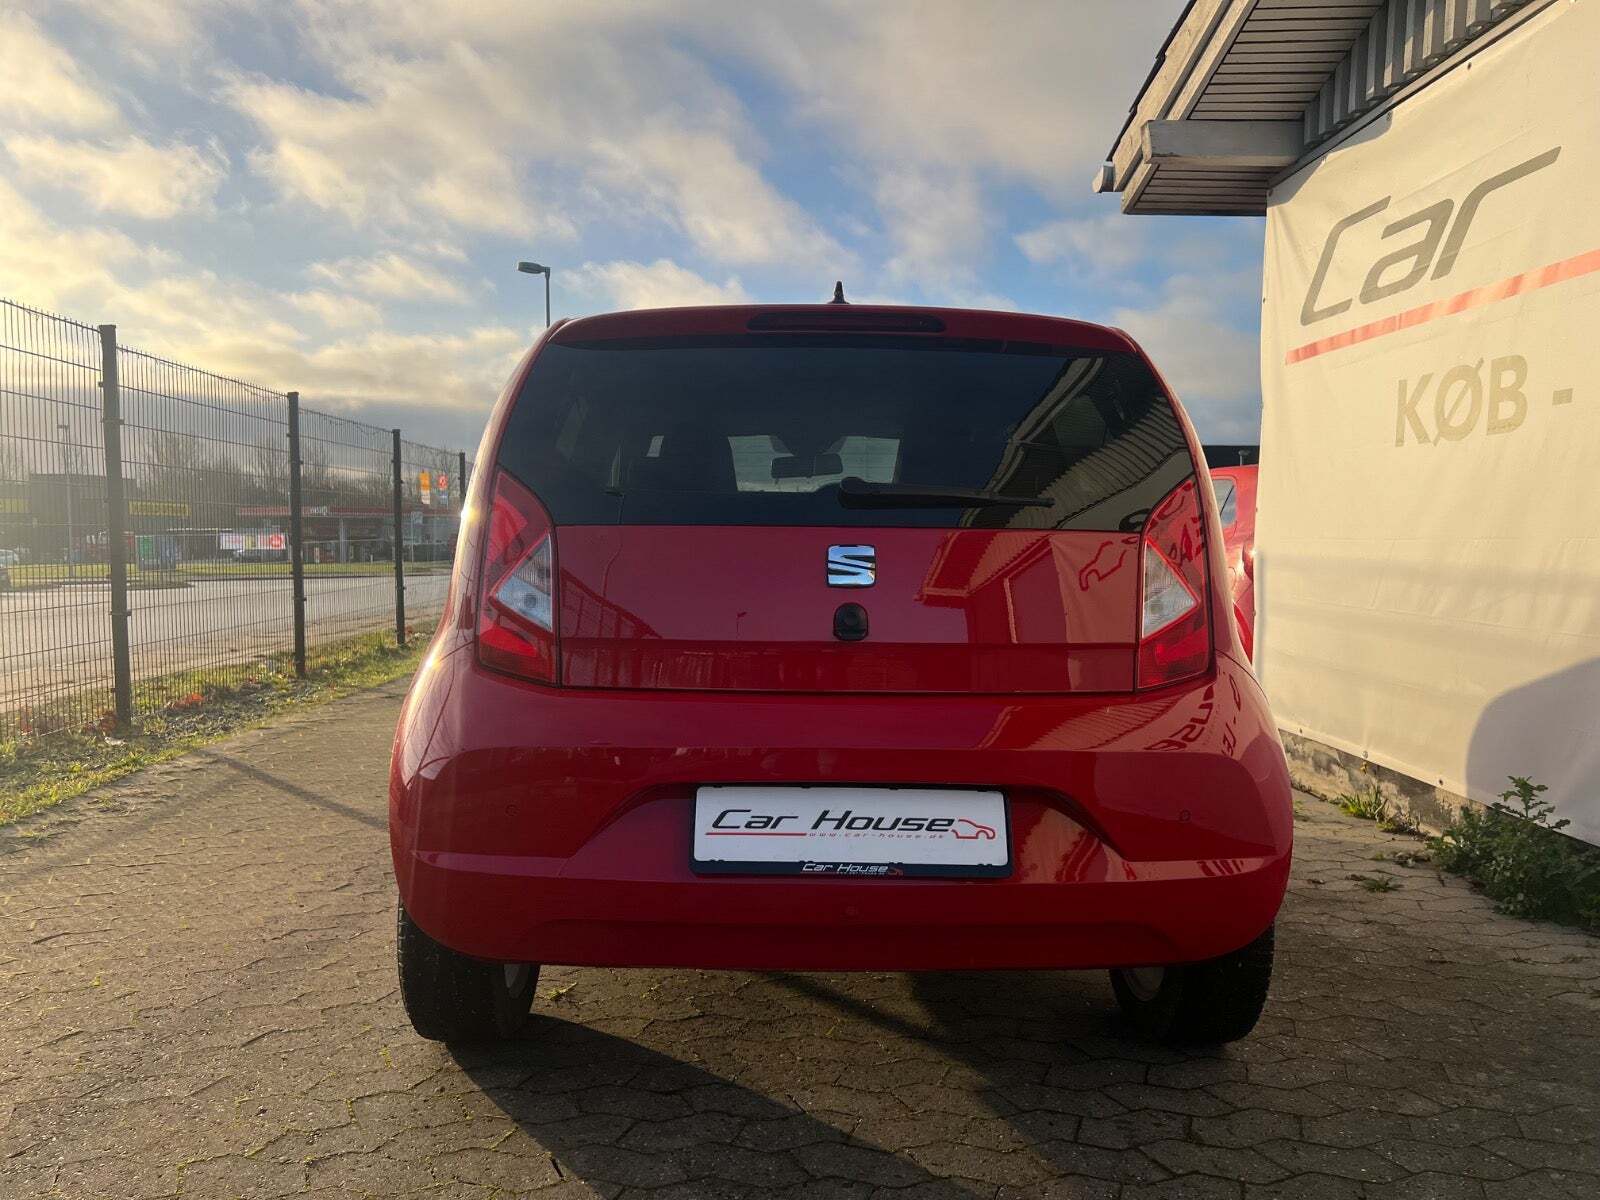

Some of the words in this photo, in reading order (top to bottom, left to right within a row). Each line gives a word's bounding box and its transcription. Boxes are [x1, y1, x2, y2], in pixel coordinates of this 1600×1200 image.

[1300, 146, 1562, 326] Car
[1395, 355, 1528, 448] KØB
[712, 809, 799, 829] Car
[811, 810, 955, 832] House
[802, 863, 833, 872] Car
[837, 863, 888, 873] House
